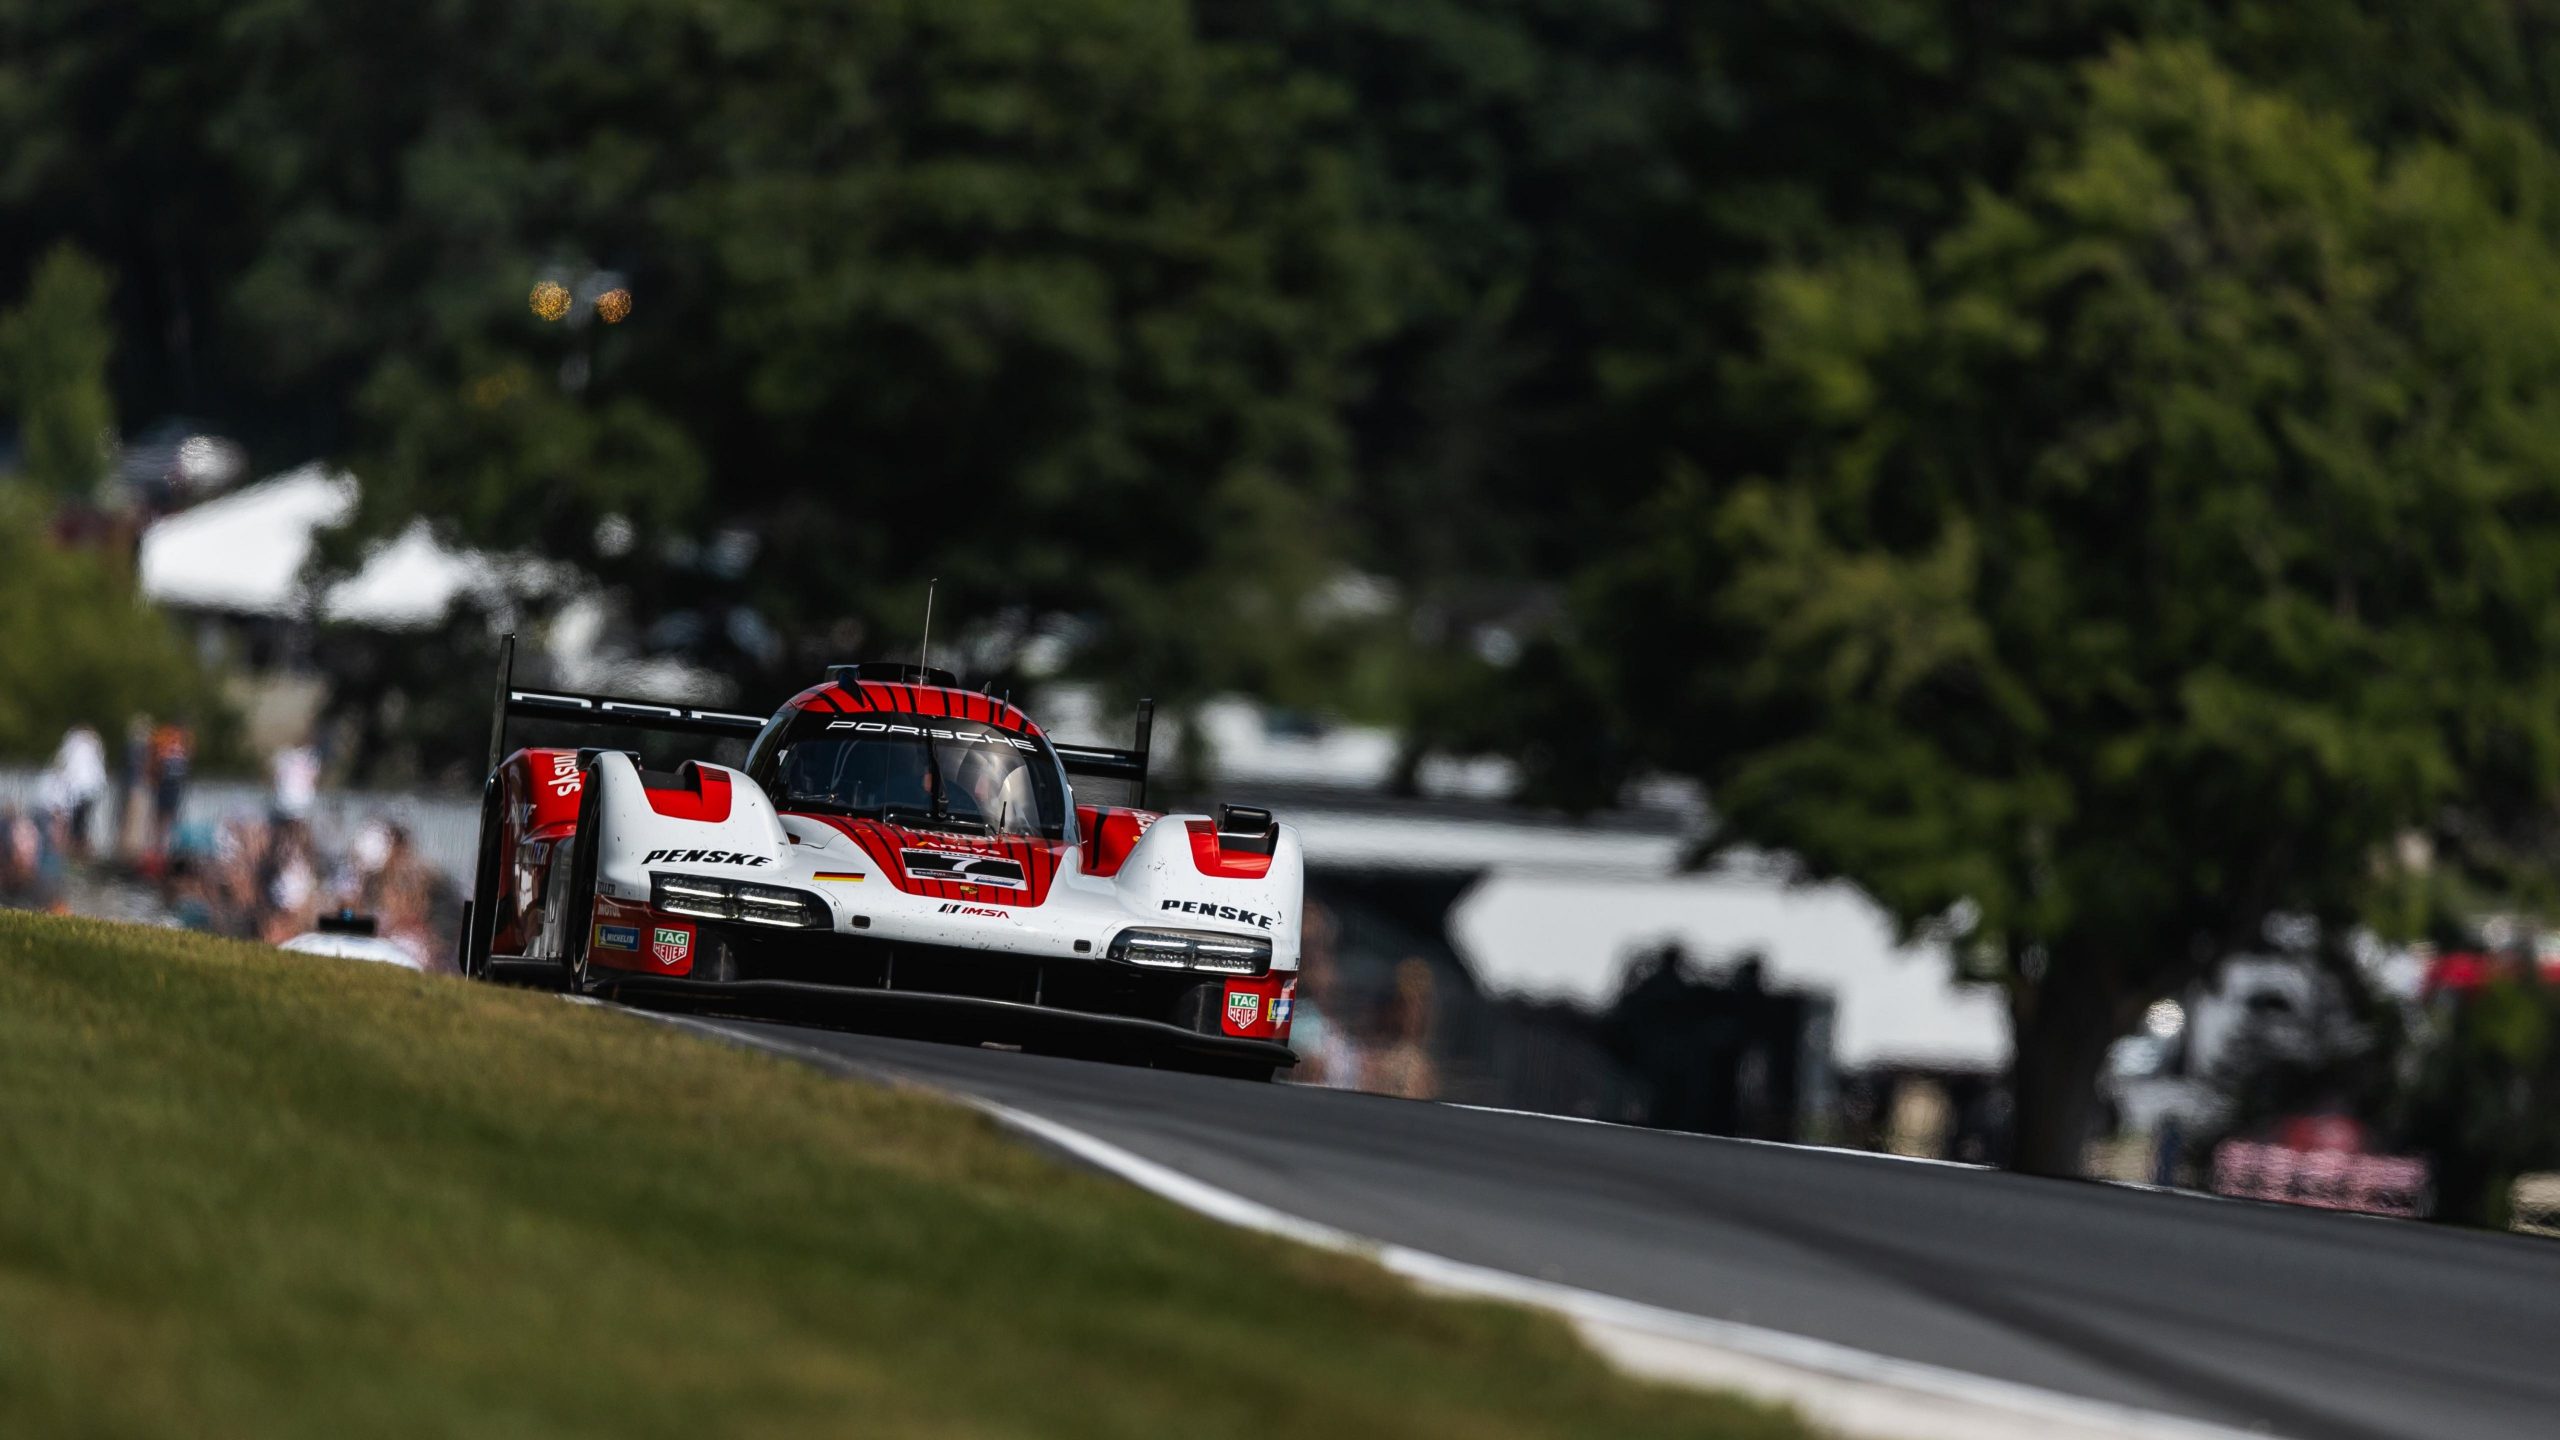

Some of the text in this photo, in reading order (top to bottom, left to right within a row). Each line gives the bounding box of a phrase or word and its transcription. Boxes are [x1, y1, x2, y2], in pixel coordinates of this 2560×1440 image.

[826, 720, 1038, 752] PORSCHE
[916, 841, 1001, 855] Ansys
[641, 849, 773, 867] PENSKE
[940, 855, 982, 872] 7
[961, 907, 1009, 919] IMSA
[1161, 899, 1273, 930] PENSKE
[606, 933, 635, 944] MICHELIN
[657, 931, 685, 945] TAG
[655, 944, 687, 962] HEUER
[1232, 994, 1257, 1007] TAG
[1230, 1007, 1257, 1026] HEUER
